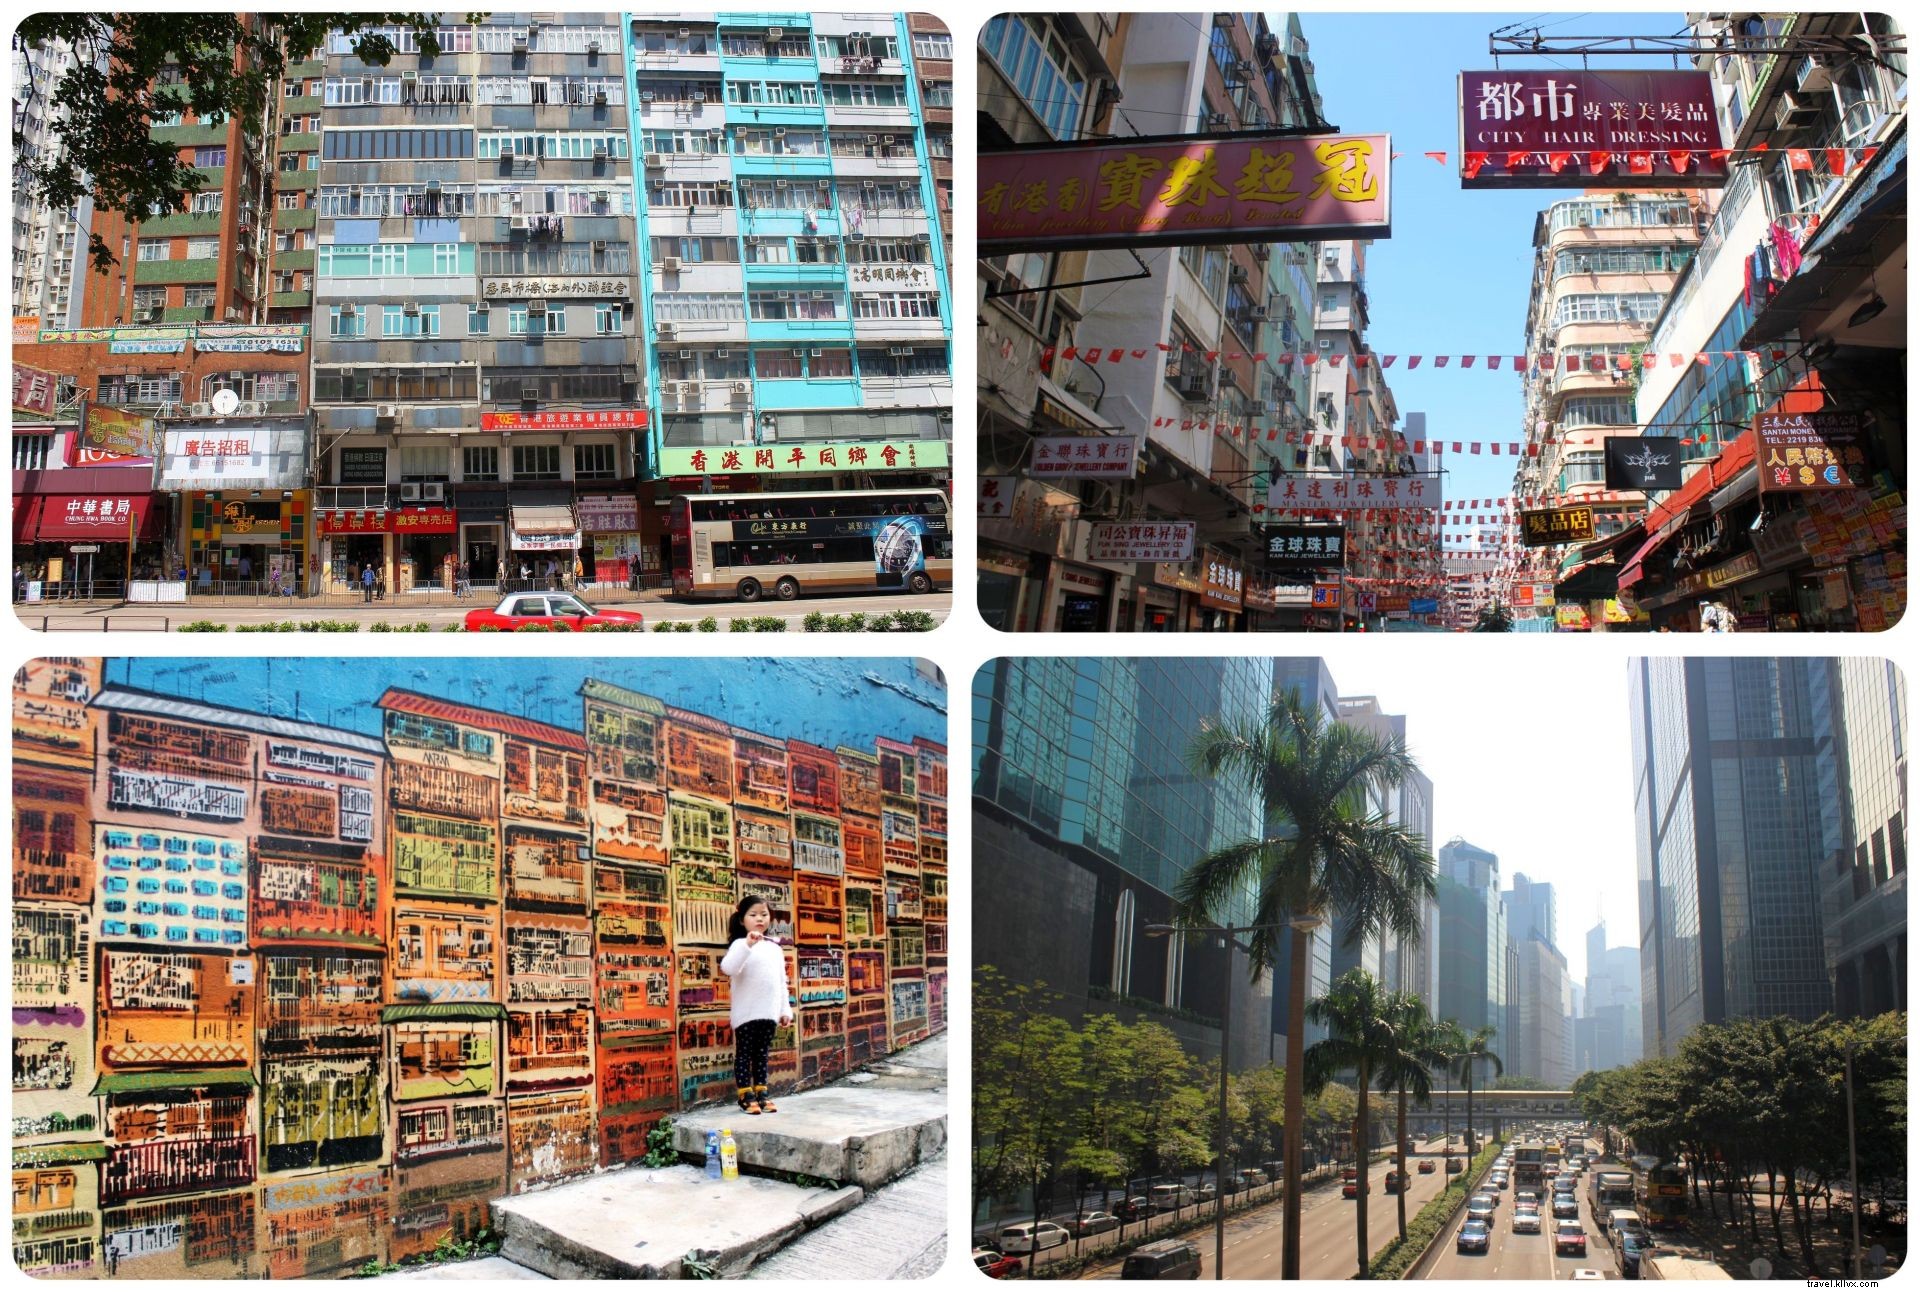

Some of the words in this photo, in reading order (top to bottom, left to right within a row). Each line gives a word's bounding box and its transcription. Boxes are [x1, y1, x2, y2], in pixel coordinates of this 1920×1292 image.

[1478, 131, 1526, 143] CITY
[1544, 131, 1595, 143] HAIR
[1611, 131, 1708, 143] DRESSING
[185, 439, 250, 456] 廣告招租
[690, 445, 901, 472] 香港開平同鄉會
[1283, 480, 1425, 499] 美達利珠寶行
[66, 499, 130, 516] 中華書局
[1269, 536, 1341, 553] 金球珠寶
